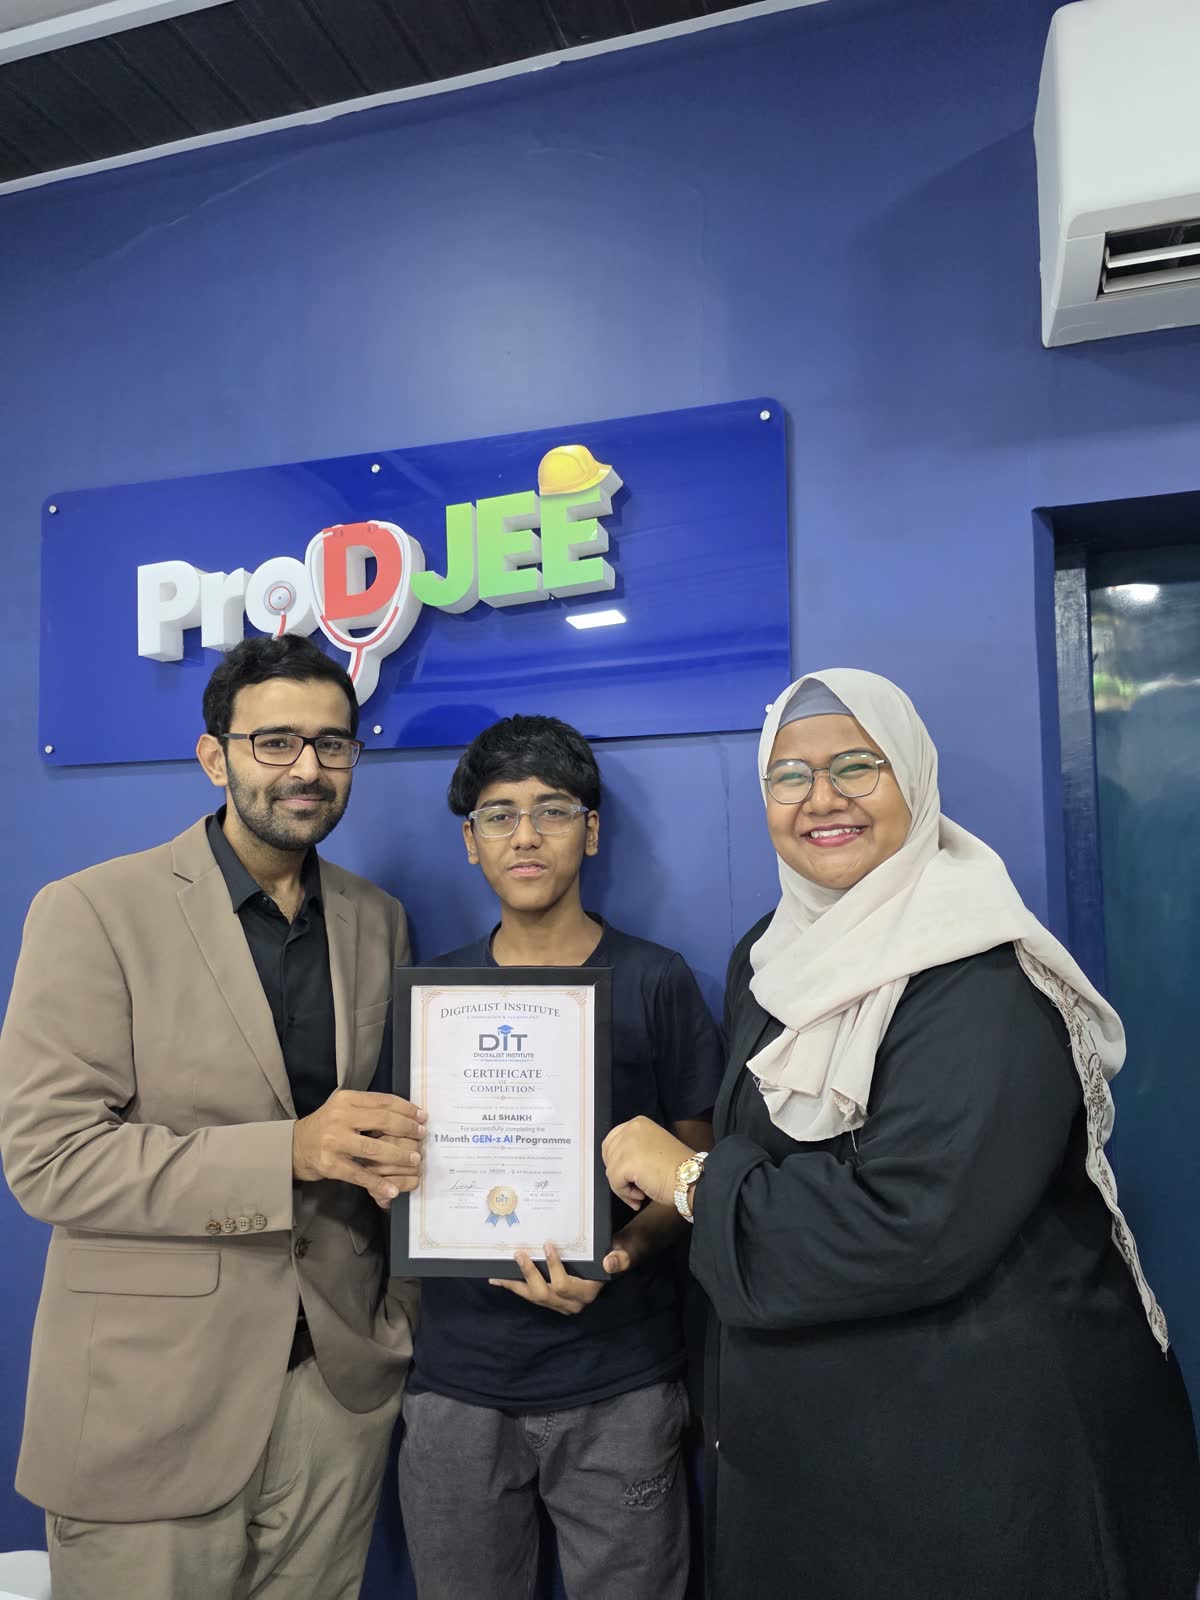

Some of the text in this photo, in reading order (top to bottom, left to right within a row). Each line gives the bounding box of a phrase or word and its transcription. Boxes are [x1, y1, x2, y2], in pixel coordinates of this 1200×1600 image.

[440, 1002, 561, 1018] DIGITALIST INSTITUTE
[463, 1068, 543, 1079] CERTIFICATE
[470, 1085, 536, 1093] COMPLETION
[481, 1113, 532, 1122] ALI SHAIKH
[440, 1134, 470, 1143] Month
[471, 1135, 502, 1144] GEN-z
[503, 1135, 513, 1144] AI
[515, 1135, 572, 1146] Programme
